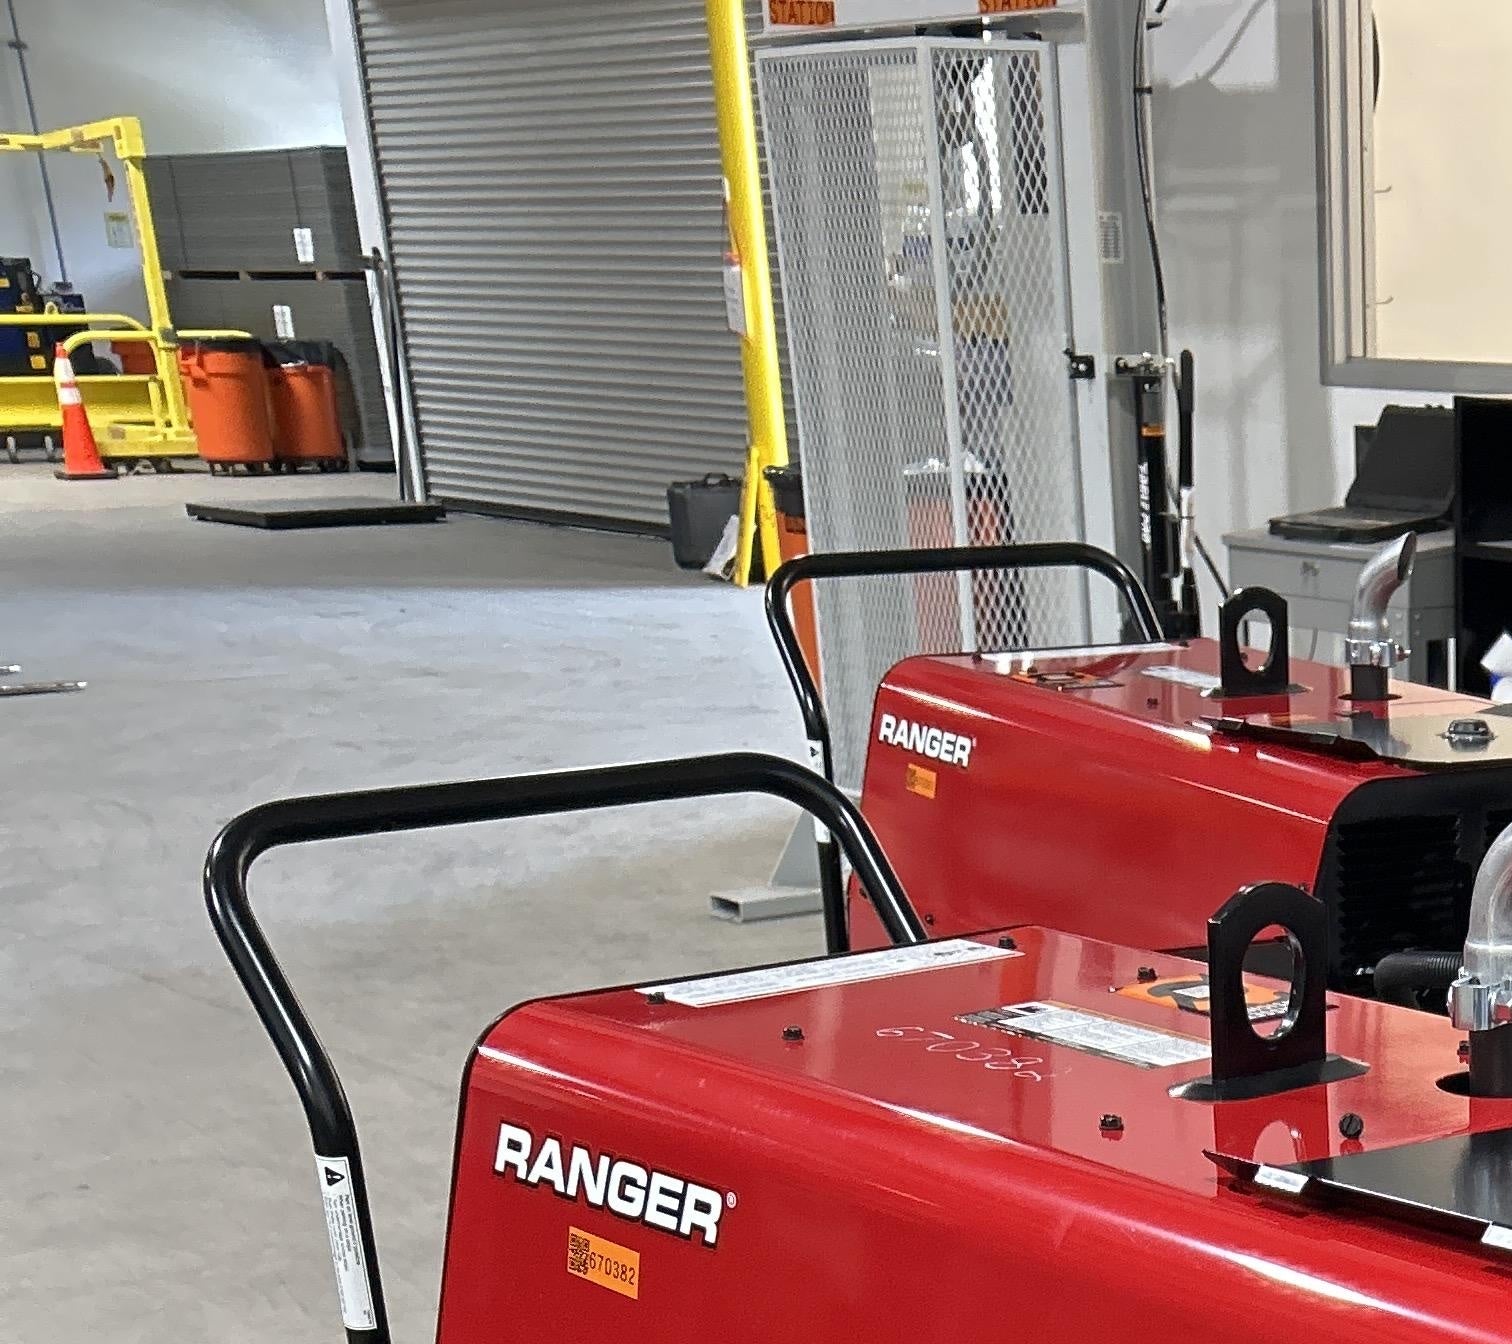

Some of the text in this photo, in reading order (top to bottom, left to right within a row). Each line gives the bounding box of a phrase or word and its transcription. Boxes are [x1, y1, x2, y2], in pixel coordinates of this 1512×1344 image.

[879, 713, 972, 768] RANGER
[494, 1122, 723, 1244] RANGER
[588, 1250, 637, 1286] 670382
